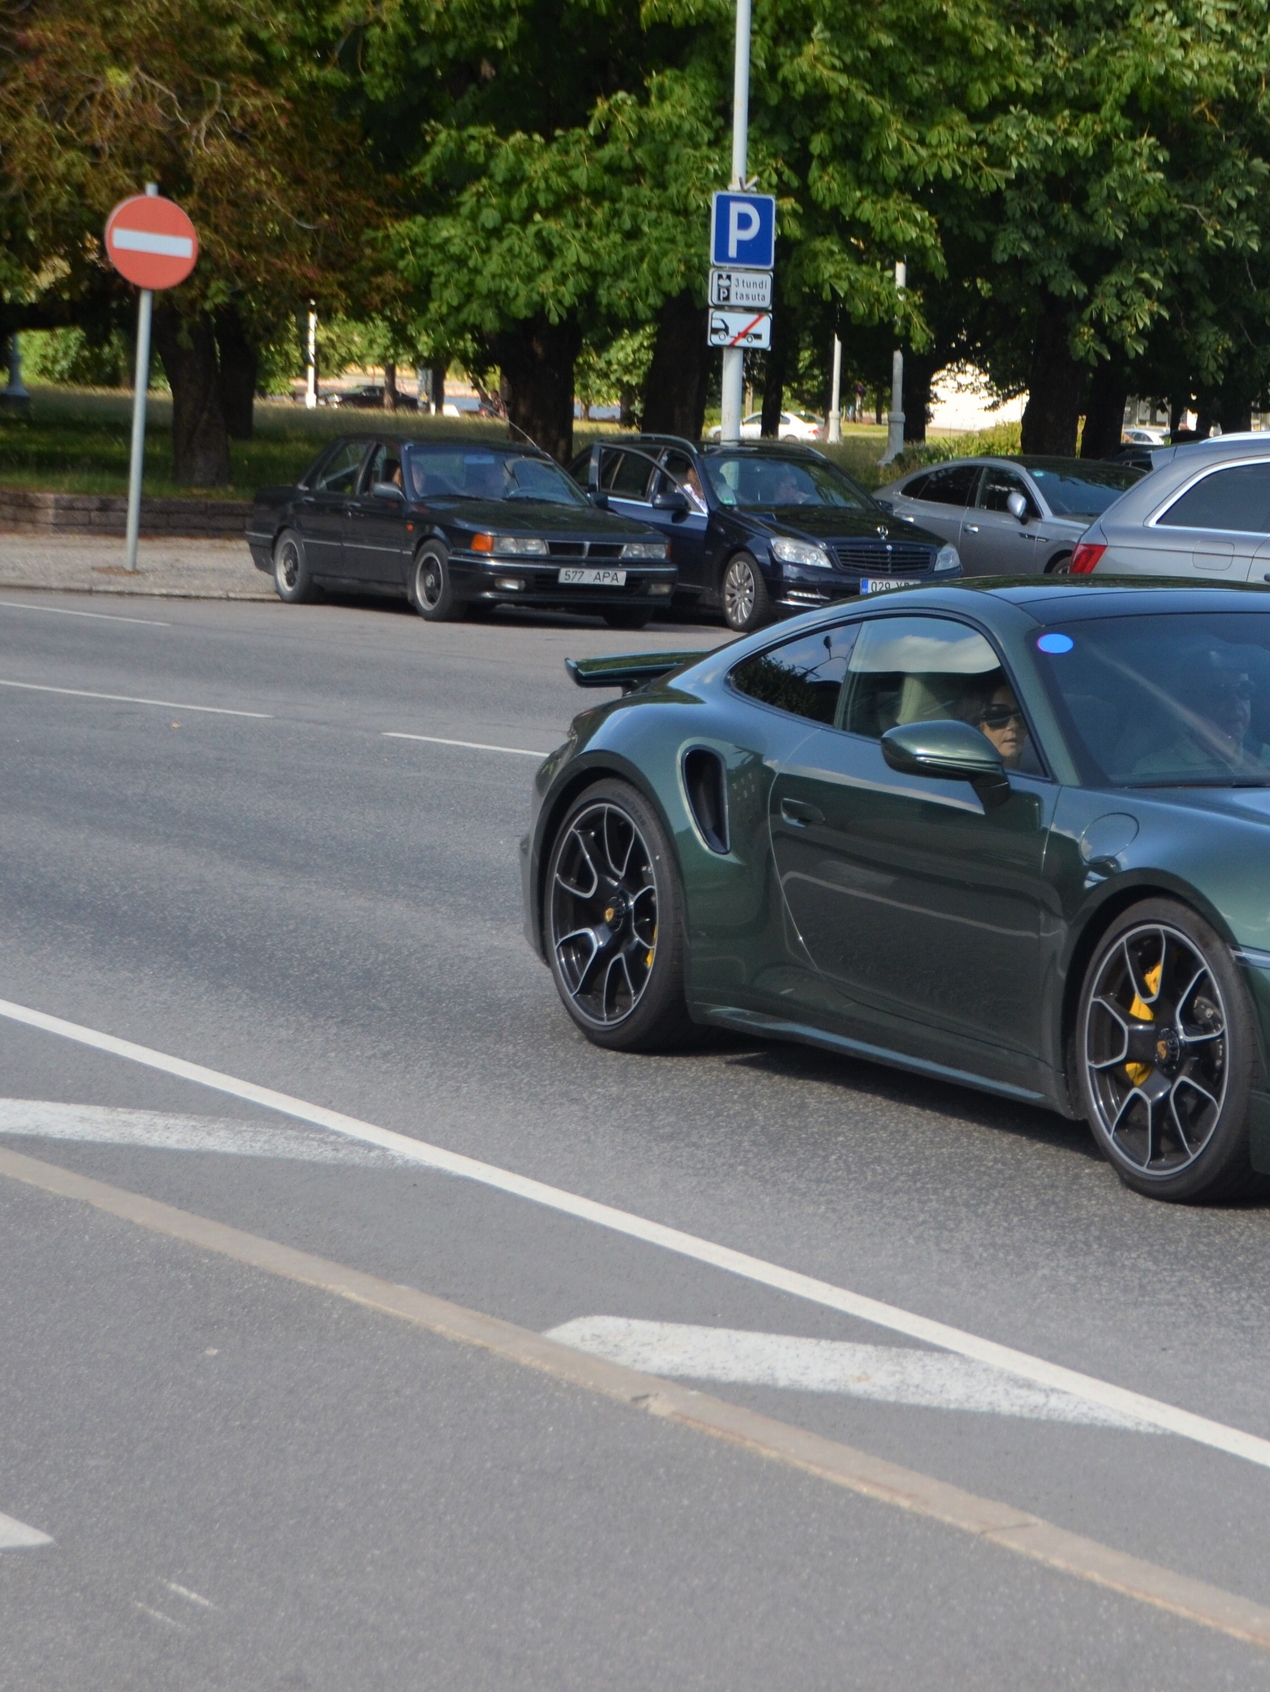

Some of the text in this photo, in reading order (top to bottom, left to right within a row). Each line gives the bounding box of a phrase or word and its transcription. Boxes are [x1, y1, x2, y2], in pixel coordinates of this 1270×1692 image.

[728, 201, 760, 258] P
[734, 278, 767, 289] 3 tundi
[735, 292, 766, 302] tasuta
[564, 570, 619, 583] 577 APA
